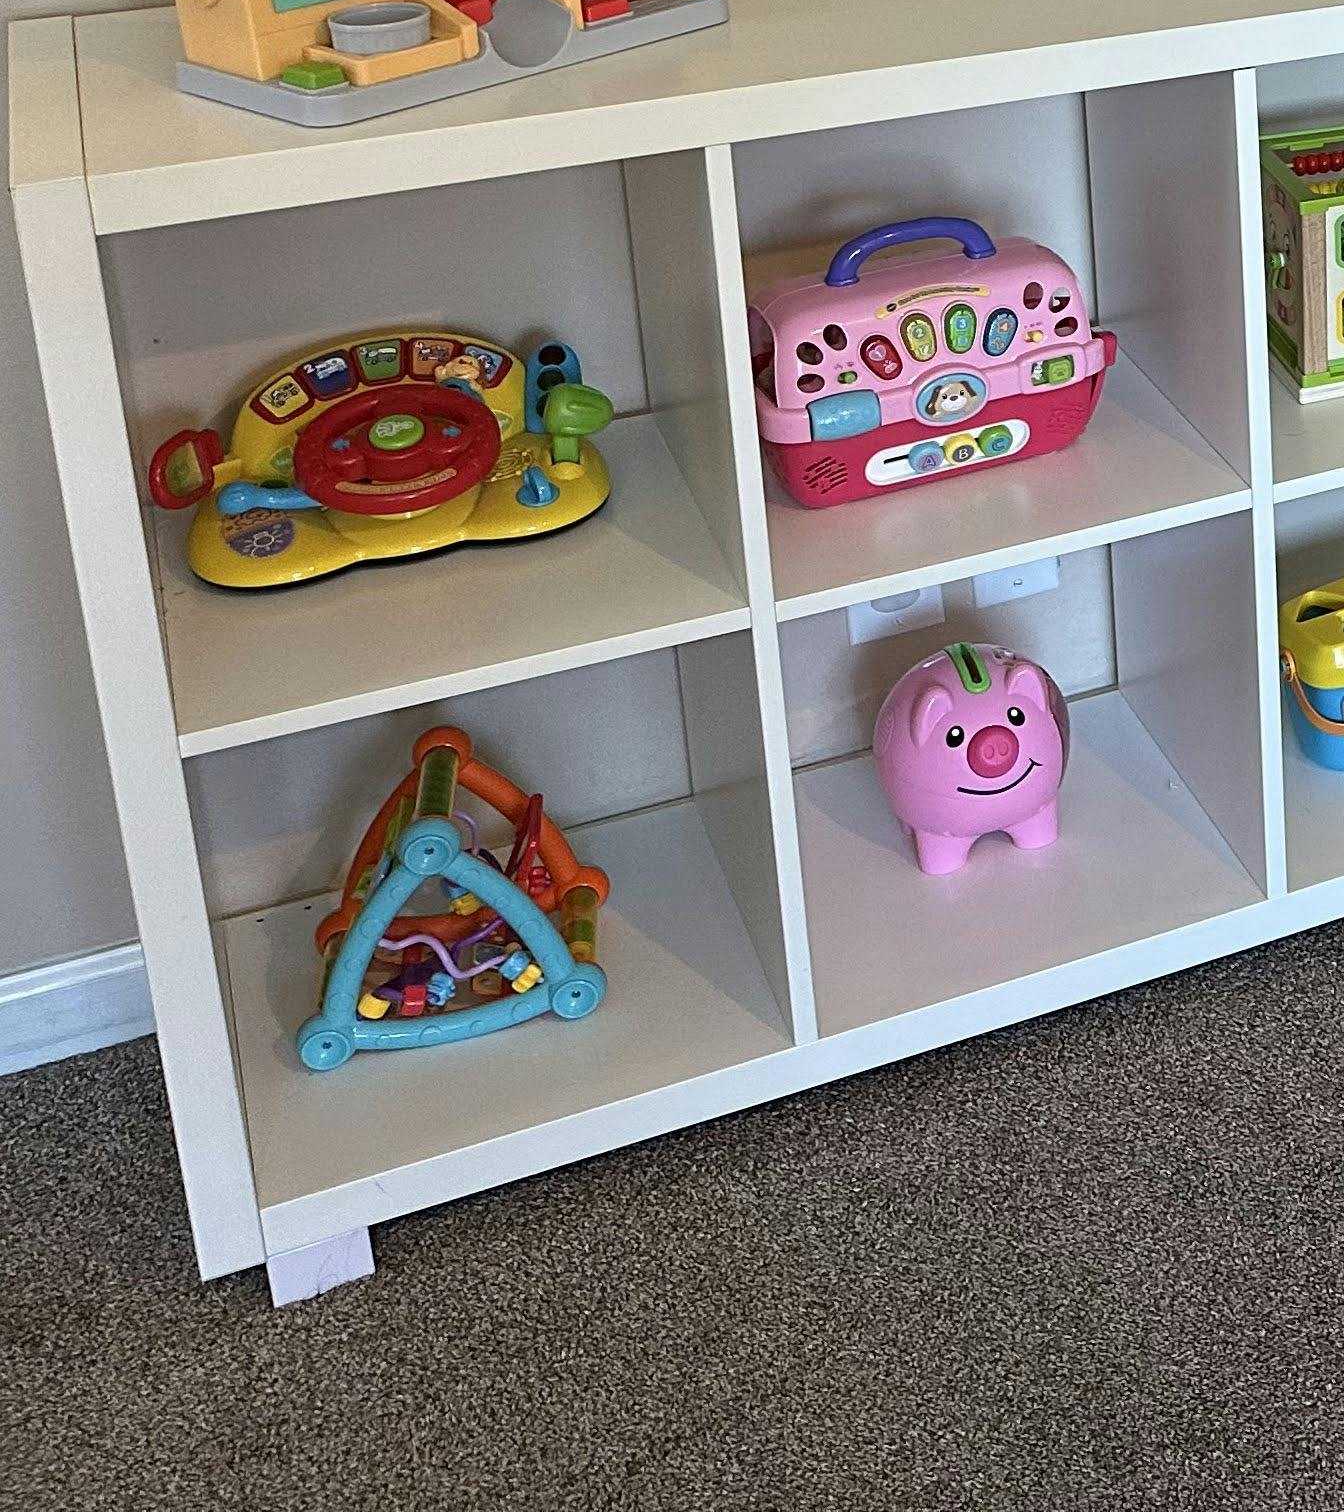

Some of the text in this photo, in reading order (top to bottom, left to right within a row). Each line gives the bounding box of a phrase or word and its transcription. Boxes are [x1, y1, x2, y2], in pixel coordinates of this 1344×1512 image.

[992, 438, 1004, 451] C
[959, 448, 968, 459] B
[923, 455, 936, 467] A
